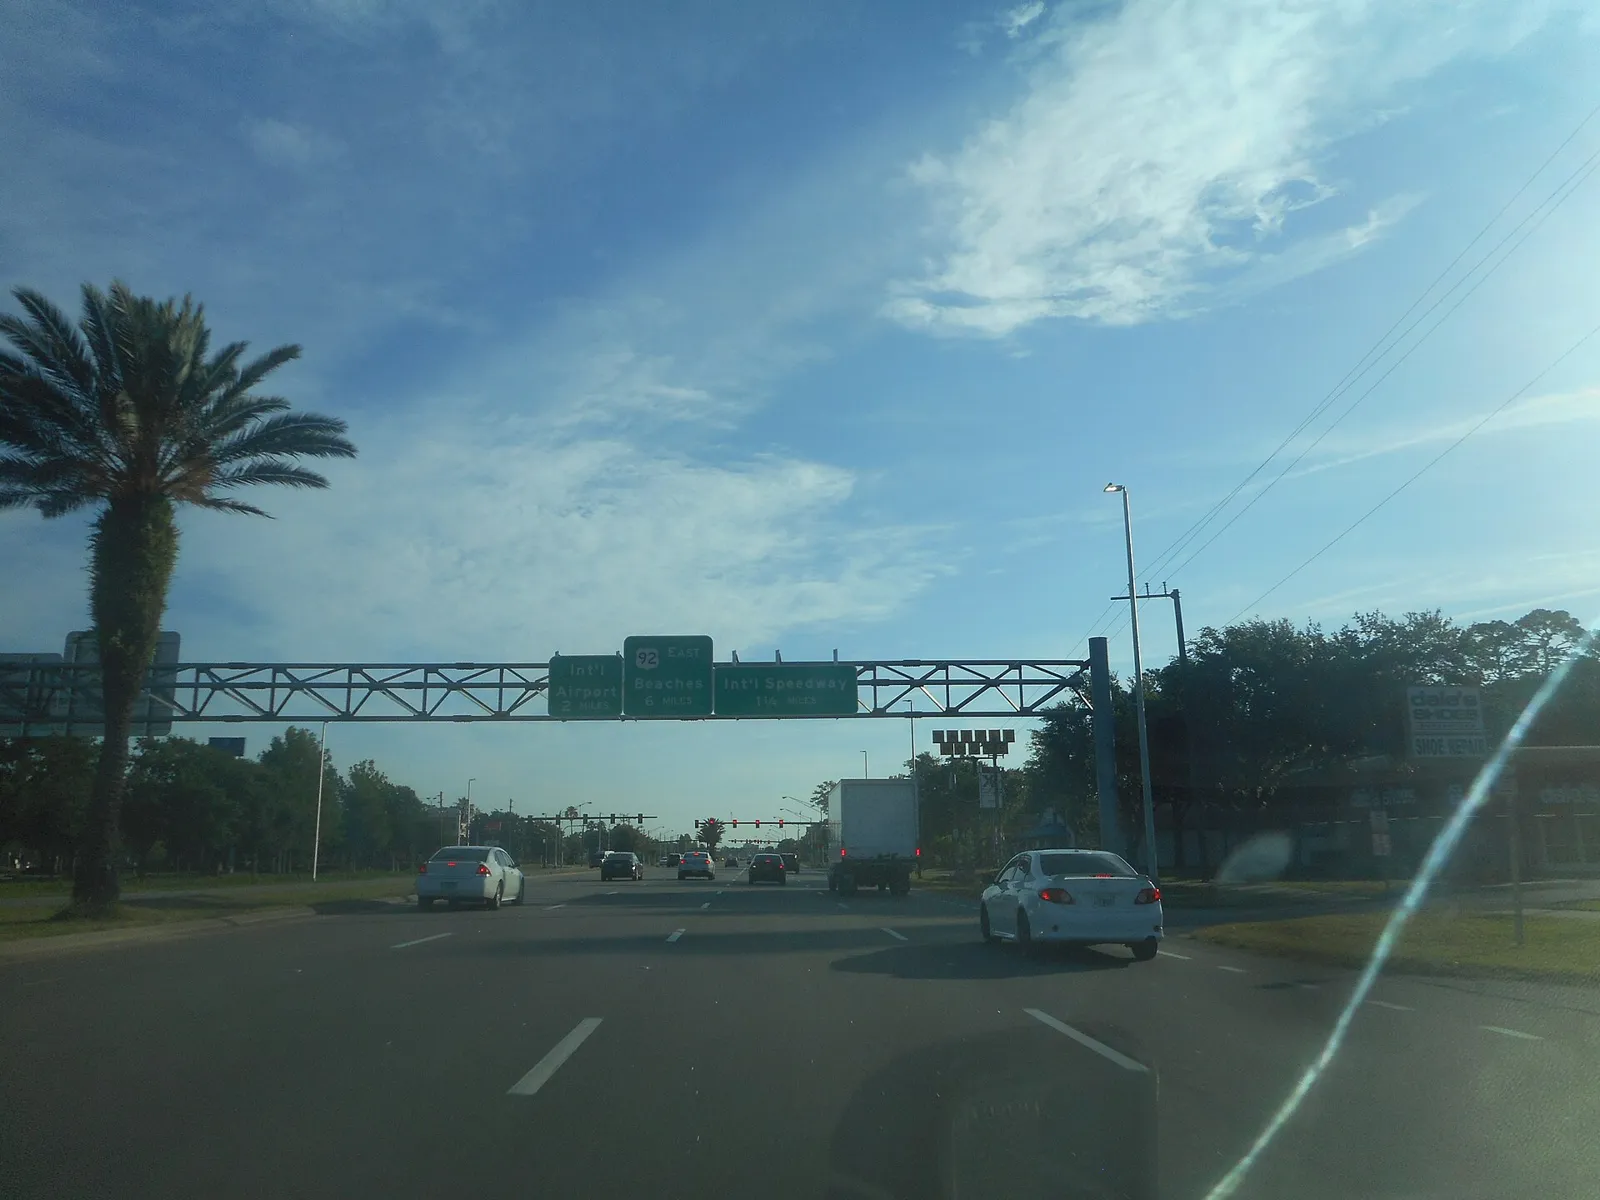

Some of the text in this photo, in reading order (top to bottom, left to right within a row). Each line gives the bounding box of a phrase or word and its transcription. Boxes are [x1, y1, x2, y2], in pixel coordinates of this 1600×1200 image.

[638, 646, 700, 665] 92 EAST
[570, 663, 604, 676] Int'l
[634, 677, 704, 691] Beaches
[724, 676, 848, 692] Int'l Speedway
[555, 685, 617, 700] Airport
[561, 700, 609, 712] 2 MILES
[644, 695, 693, 707] 6 MILES
[787, 696, 817, 706] MILES
[1415, 738, 1445, 756] SHOE
